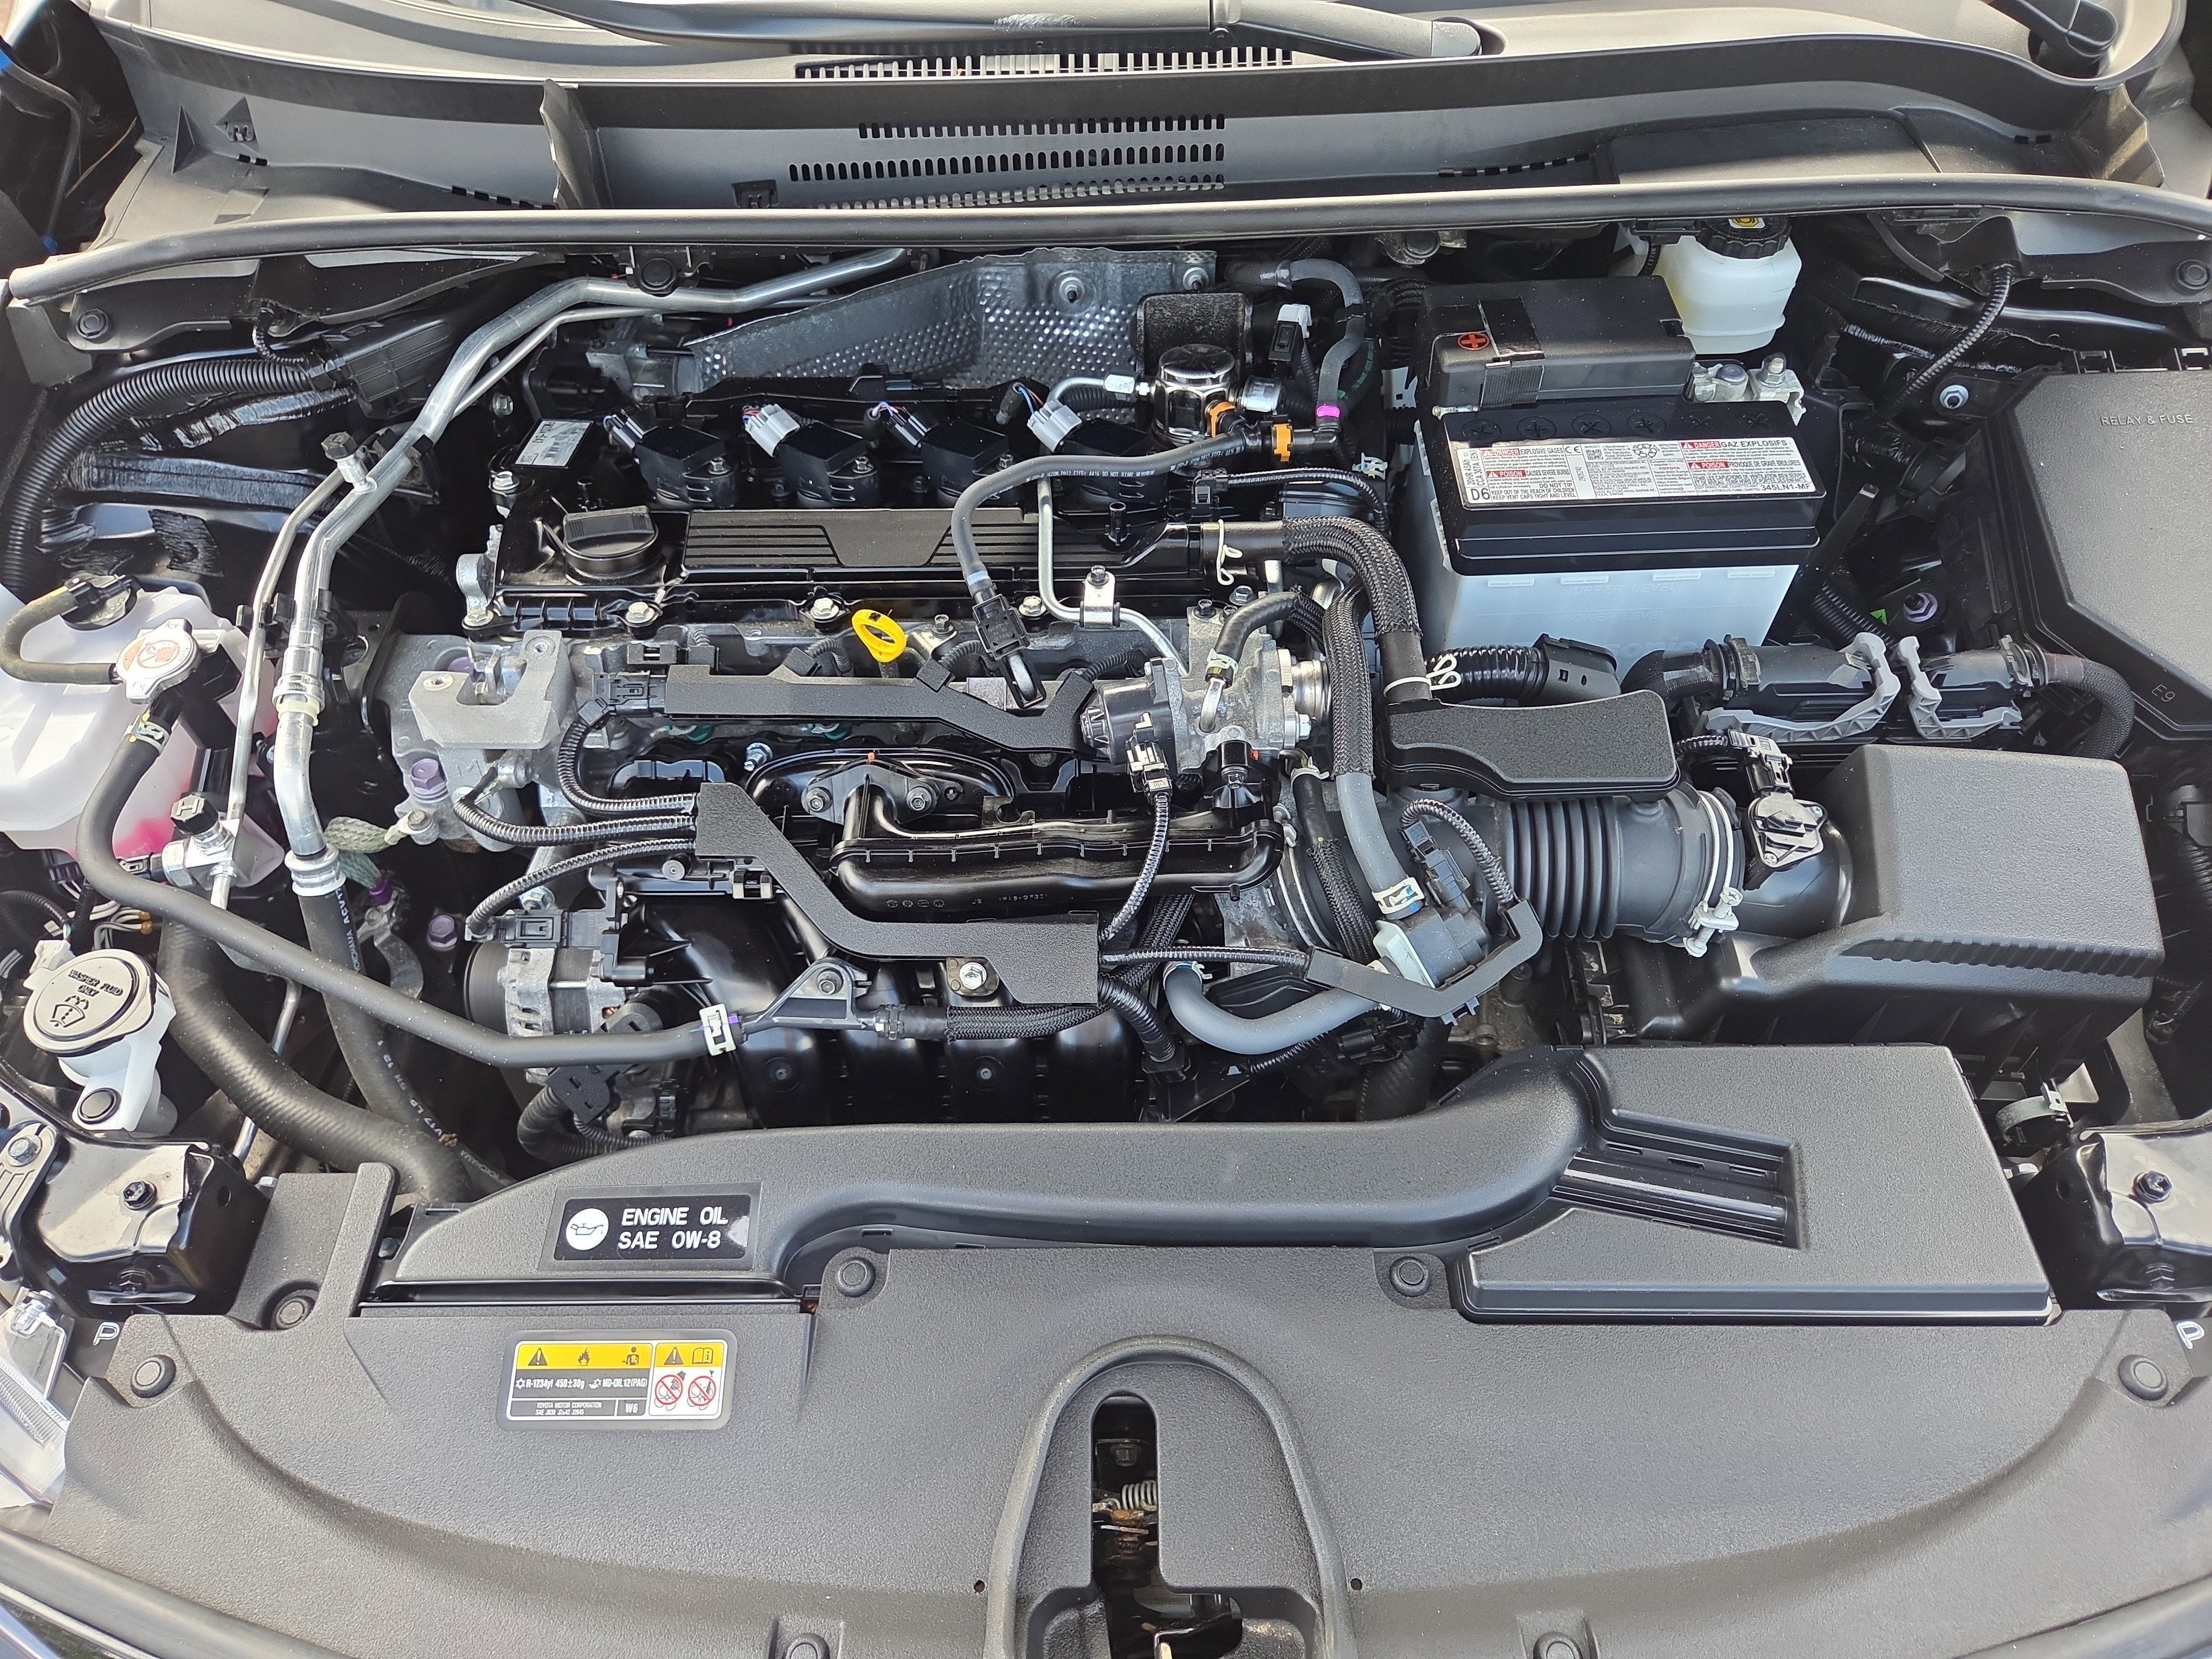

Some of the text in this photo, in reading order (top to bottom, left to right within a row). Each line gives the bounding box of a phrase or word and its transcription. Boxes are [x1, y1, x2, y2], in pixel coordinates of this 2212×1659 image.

[2100, 414, 2194, 426] RELAY & FUSE
[1471, 487, 1490, 500] D6
[1760, 483, 1811, 491] 345LN1-MF
[1573, 583, 1675, 595] UPPER LEVEL
[1624, 610, 1666, 621] LEVEL
[176, 798, 200, 816] H
[68, 969, 124, 996] WASHER FLUID
[78, 985, 100, 996] ONLY
[621, 1206, 729, 1227] ENGINE OIL
[617, 1230, 721, 1250] SAE 0W-8
[92, 1322, 120, 1346] P
[2176, 1321, 2205, 1349] P
[555, 1378, 586, 1390] 450±30g
